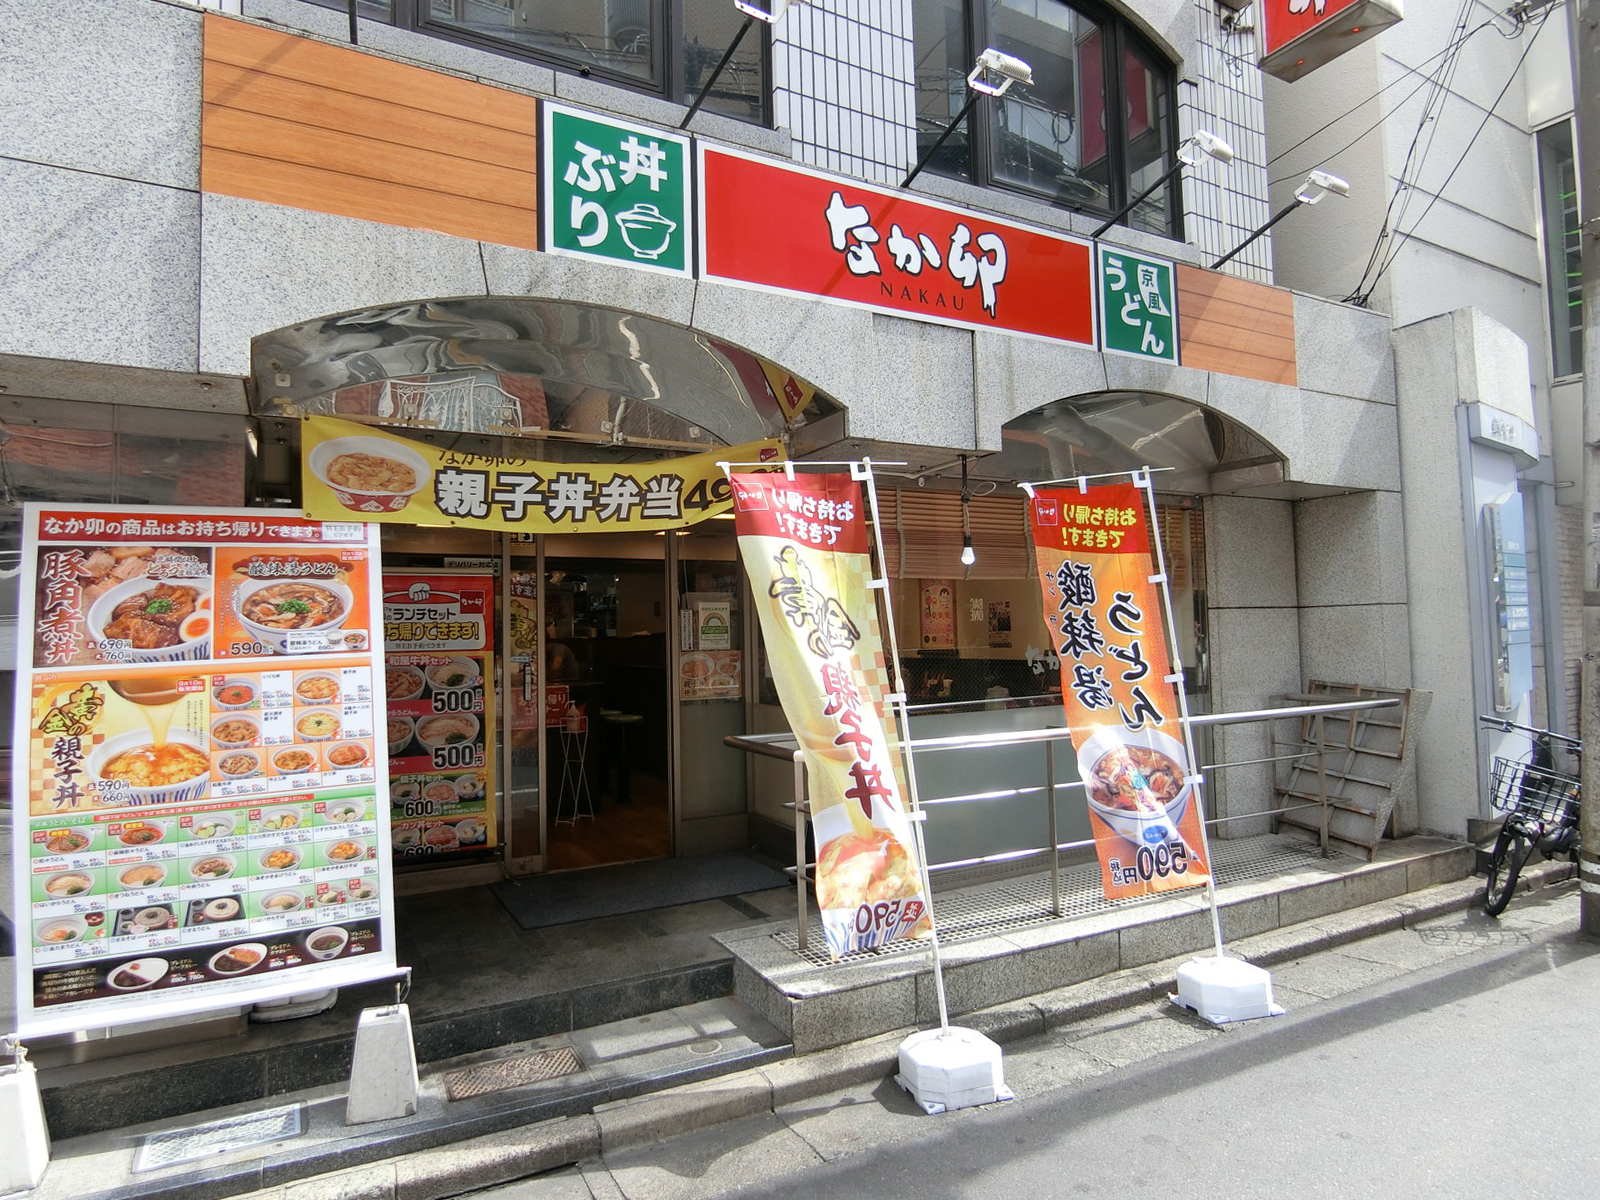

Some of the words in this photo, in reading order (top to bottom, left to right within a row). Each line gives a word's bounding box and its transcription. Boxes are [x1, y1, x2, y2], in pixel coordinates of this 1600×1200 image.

[825, 191, 1007, 319] なか卯
[880, 281, 964, 310] NAKAU
[1105, 256, 1165, 354] うどん
[1141, 268, 1162, 311] 京風
[434, 466, 685, 523] 親子丼弁当
[51, 736, 85, 809] 親子丼
